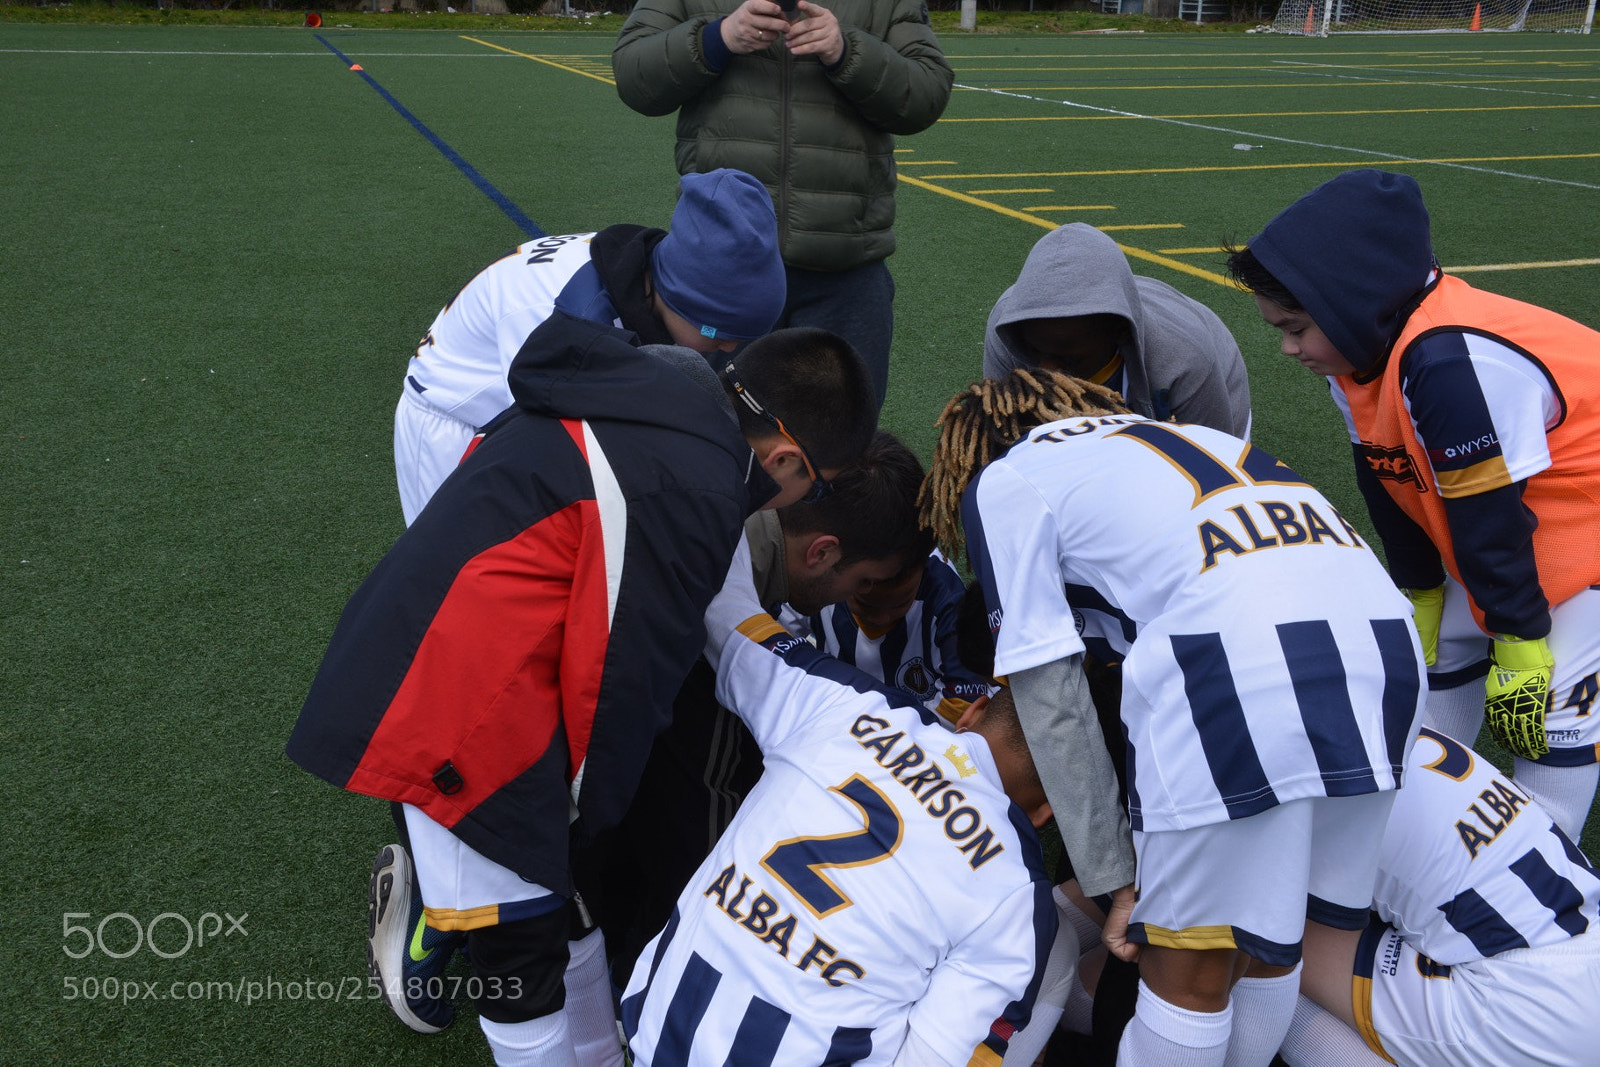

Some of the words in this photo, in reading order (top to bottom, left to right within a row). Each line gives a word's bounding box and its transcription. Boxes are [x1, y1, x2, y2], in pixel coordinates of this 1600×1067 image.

[526, 235, 579, 265] SON
[1197, 500, 1351, 575] ALBA
[849, 713, 1005, 872] GARRISON
[1454, 779, 1530, 862] ALBA
[758, 772, 905, 920] 2
[703, 862, 799, 959] ALBA
[798, 933, 867, 988] FC
